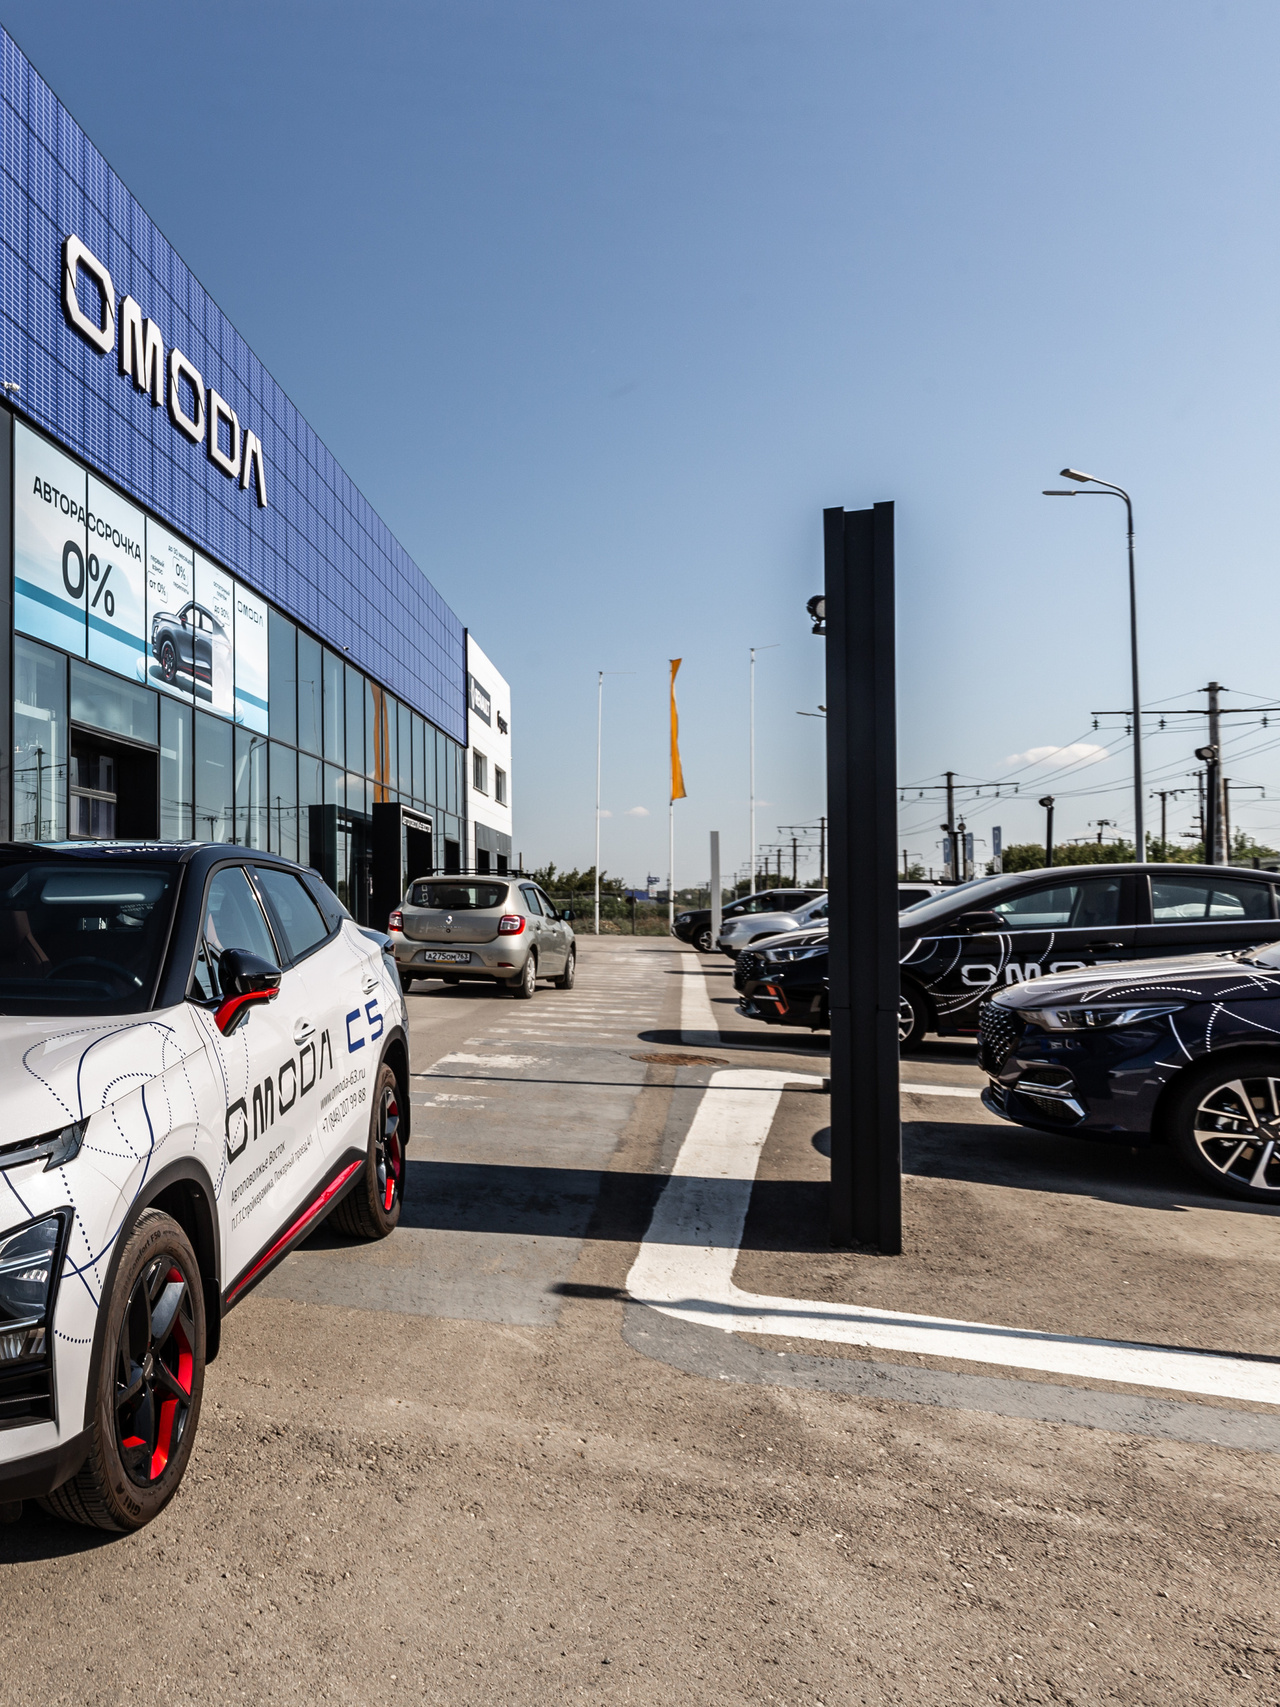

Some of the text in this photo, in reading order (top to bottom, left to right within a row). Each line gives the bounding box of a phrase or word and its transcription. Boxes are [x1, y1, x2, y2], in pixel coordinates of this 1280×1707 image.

[61, 233, 267, 508] OMODA
[33, 476, 142, 562] АВТОРАССРОЧКА
[62, 540, 115, 618] 0%
[176, 563, 186, 580] 0%
[237, 600, 264, 627] OMODA
[225, 1029, 333, 1164] OMODA
